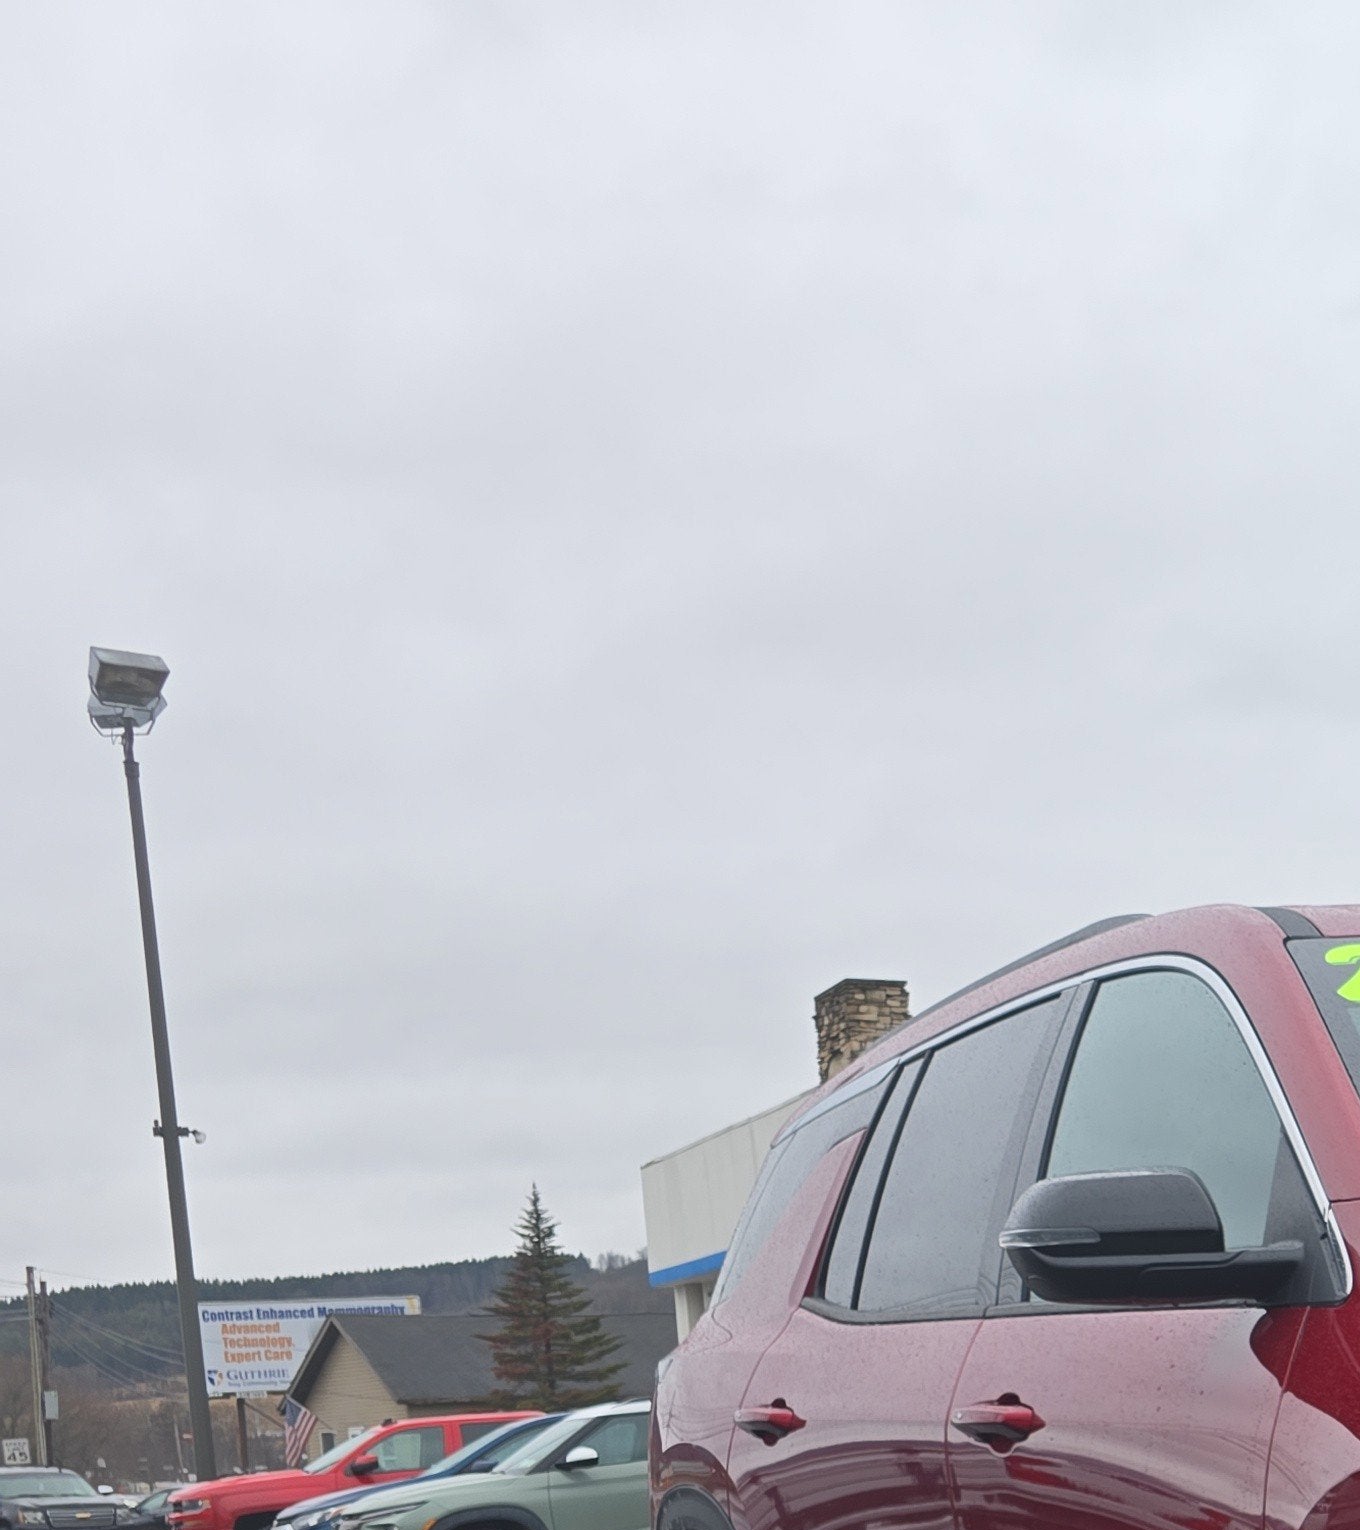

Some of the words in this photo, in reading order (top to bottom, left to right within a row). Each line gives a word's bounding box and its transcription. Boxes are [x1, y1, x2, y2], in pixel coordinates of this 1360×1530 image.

[202, 1311, 253, 1322] Contrast
[256, 1308, 314, 1320] Enhanced
[221, 1322, 280, 1335] Advanced
[224, 1350, 262, 1363] Expert
[264, 1349, 293, 1361] Care
